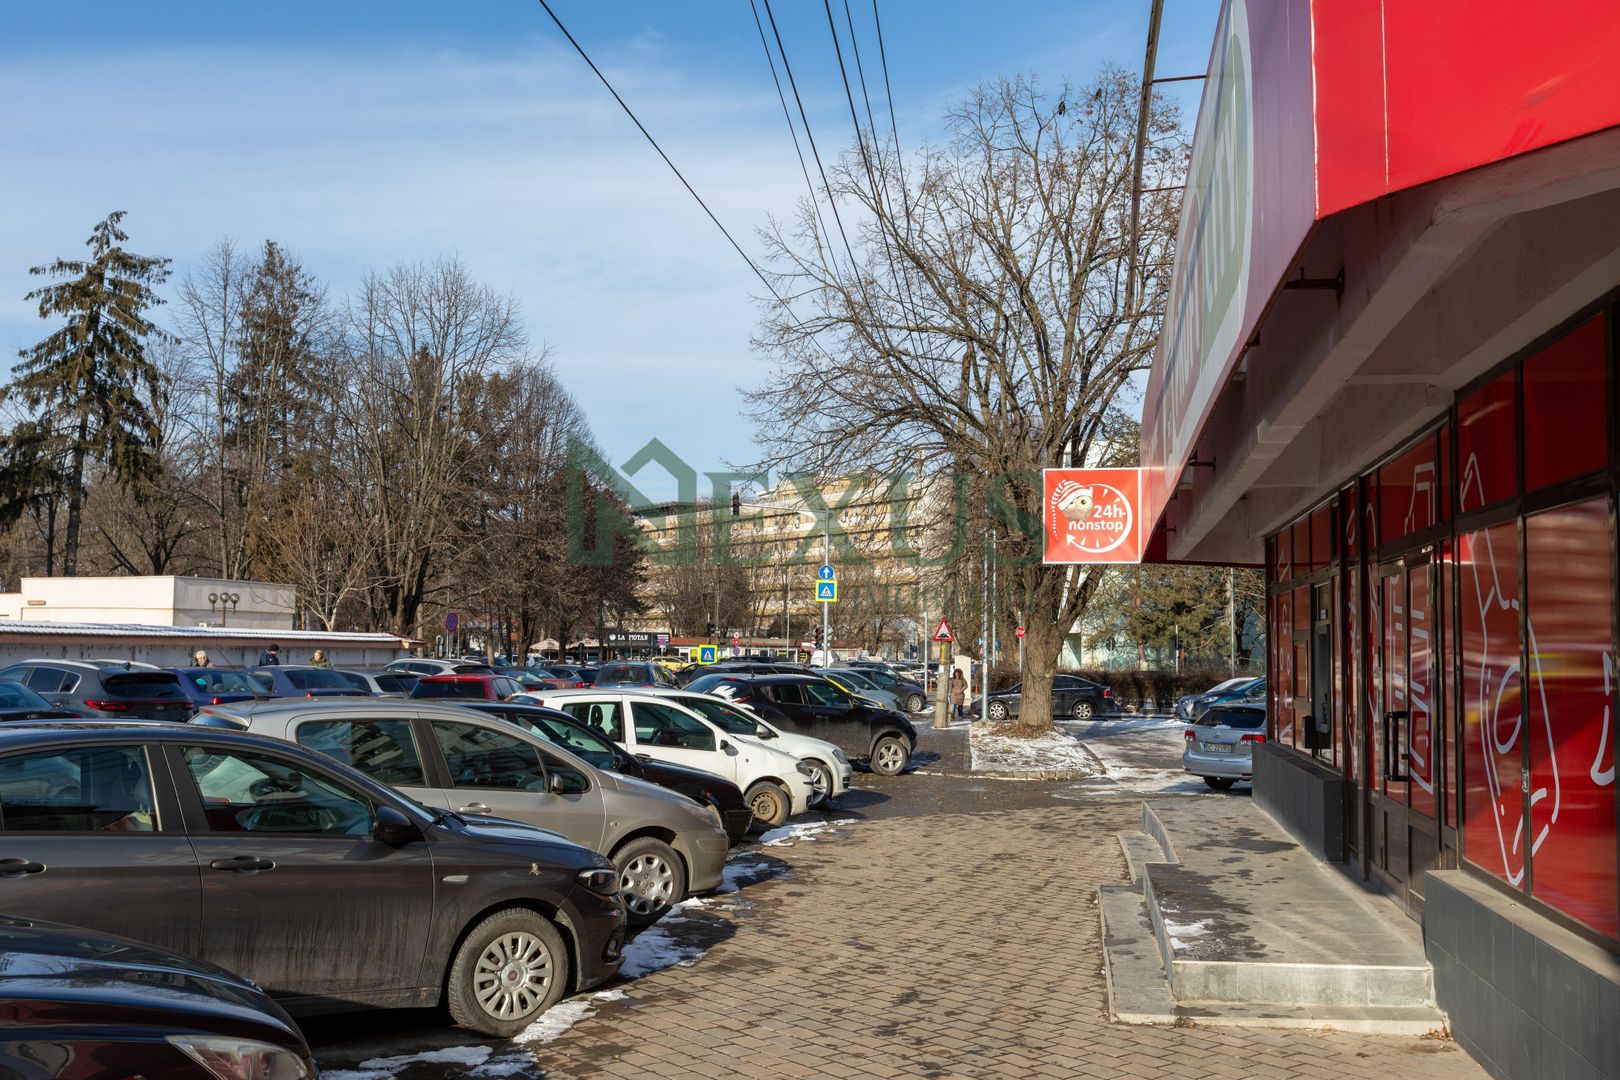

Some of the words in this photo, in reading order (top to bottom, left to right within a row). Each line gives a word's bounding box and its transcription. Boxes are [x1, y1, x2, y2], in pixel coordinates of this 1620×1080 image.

[1205, 84, 1236, 313] CITY
[1093, 505, 1123, 518] 24h
[1069, 521, 1124, 534] nonstop
